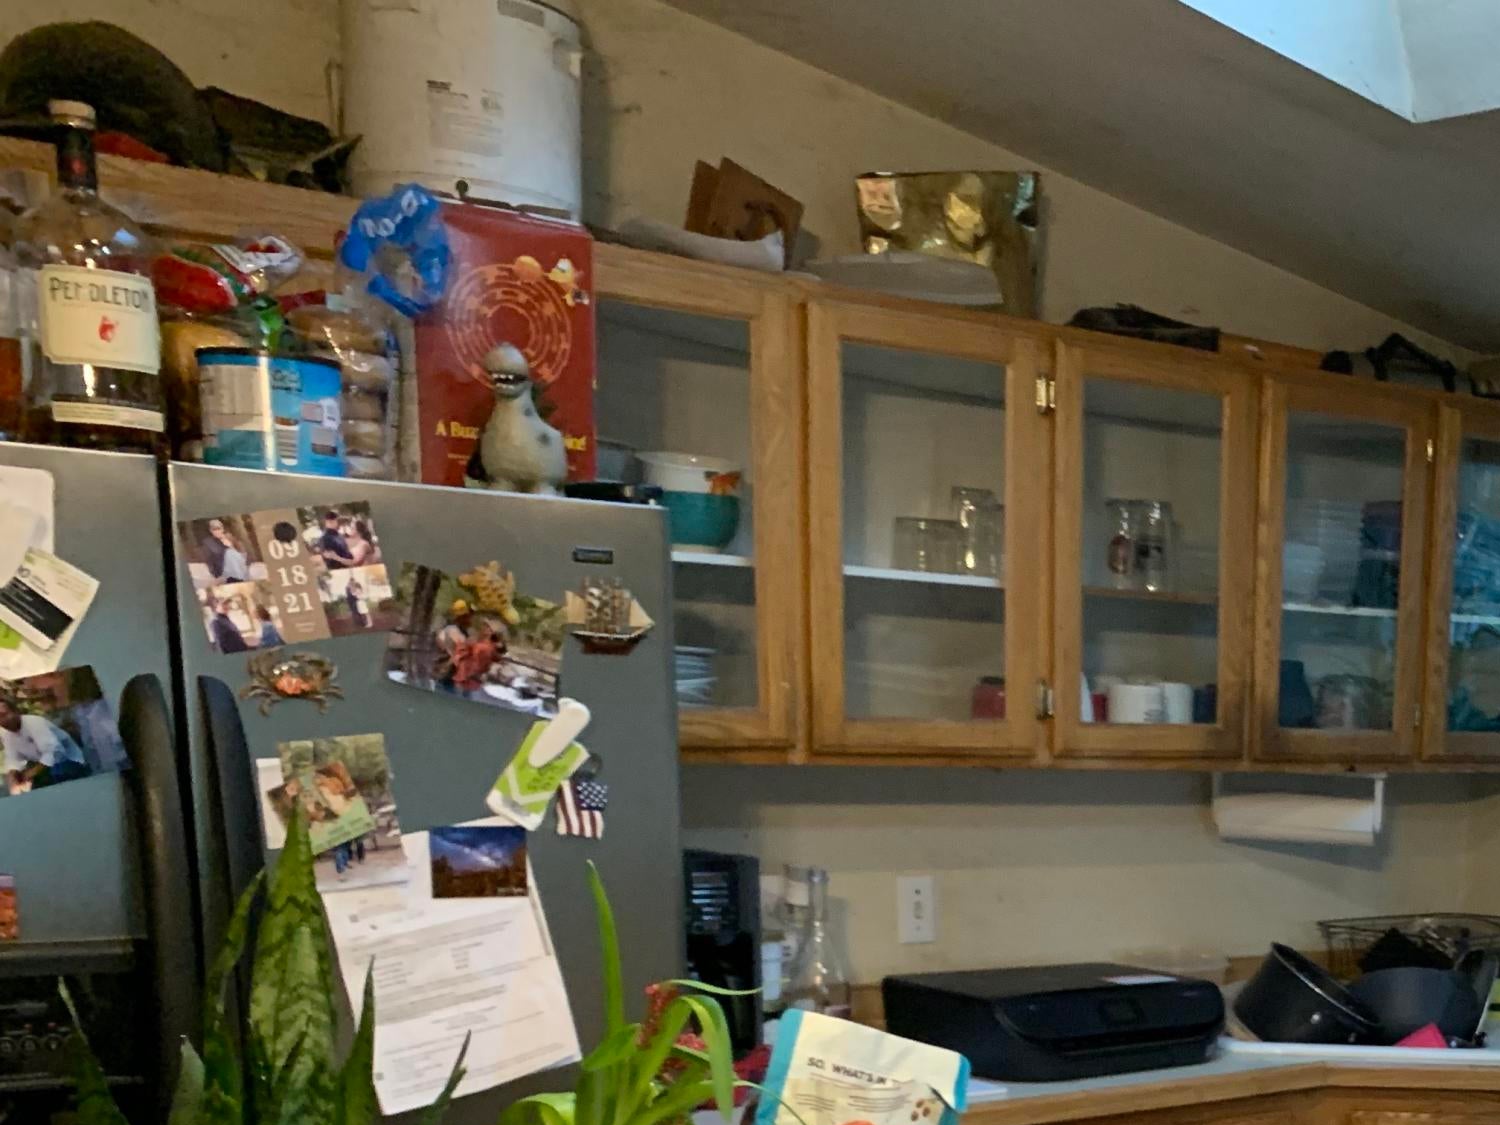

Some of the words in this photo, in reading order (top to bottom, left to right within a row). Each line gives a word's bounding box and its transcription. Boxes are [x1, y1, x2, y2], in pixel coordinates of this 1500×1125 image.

[268, 539, 299, 560] 09
[276, 564, 308, 587] 18
[283, 592, 314, 614] 21
